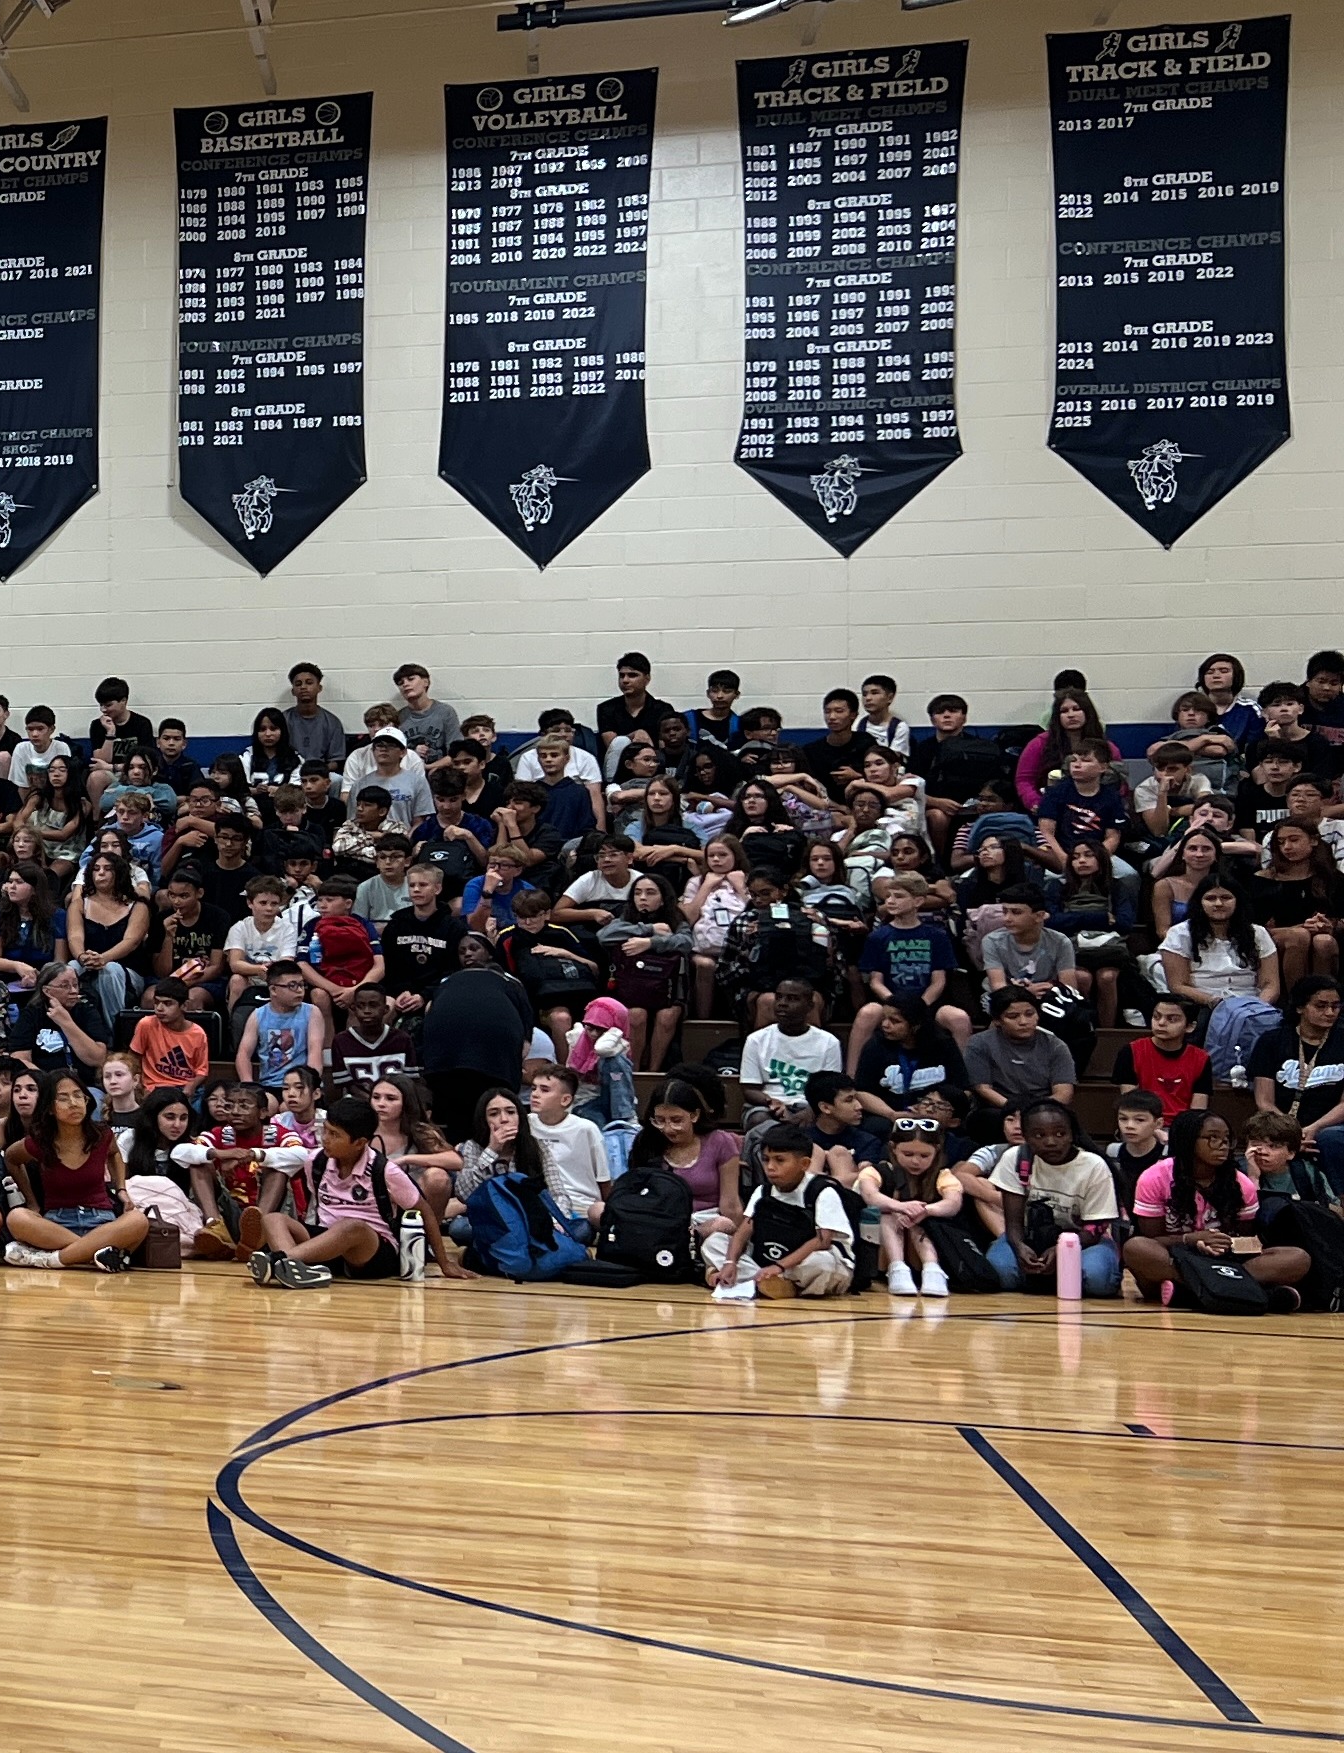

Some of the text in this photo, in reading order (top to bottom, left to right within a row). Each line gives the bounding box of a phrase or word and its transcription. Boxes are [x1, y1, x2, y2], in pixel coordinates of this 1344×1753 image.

[1127, 31, 1208, 52] GIRLS
[812, 56, 889, 78] GIRLS
[1066, 52, 1270, 82] TRACK & FIELD
[514, 84, 585, 104] GIRLS
[754, 77, 948, 108] TRACK & FIELD
[1068, 76, 1268, 102] DUAL MEET CHAMPS
[1152, 97, 1212, 110] GRADE
[238, 107, 305, 127] GIRLS
[472, 104, 627, 130] VOLLEYBALL
[1059, 117, 1134, 131] 2013 2017
[200, 126, 344, 153] BASKETBALL
[0, 150, 101, 172] COUNTRY
[258, 167, 308, 180] GRADE
[1152, 171, 1212, 185] GRADE
[1060, 194, 1092, 205] 2013
[1104, 192, 1138, 204] 2014
[1152, 189, 1186, 201] 2015
[1059, 207, 1093, 218] 2022
[1060, 231, 1281, 255] CONFERENCE CHAMPS
[1152, 252, 1213, 266] GRADE
[1058, 274, 1094, 287] 2013
[1104, 272, 1138, 285] 2015
[1195, 265, 1234, 280] 2022
[563, 307, 595, 318] 2022
[1152, 320, 1213, 334] GRADE
[533, 338, 586, 350] GRADE
[1058, 342, 1092, 354] 2013
[1103, 340, 1138, 352] 2014
[1236, 333, 1273, 345] 2023
[1058, 358, 1094, 369] 2024
[450, 383, 605, 402] 2011 2020 2022
[1057, 378, 1281, 395] OVERALL DISTRICT CHAMPS
[1057, 401, 1092, 412] 2013
[1147, 397, 1184, 409] 2017
[1055, 416, 1091, 427] 2025
